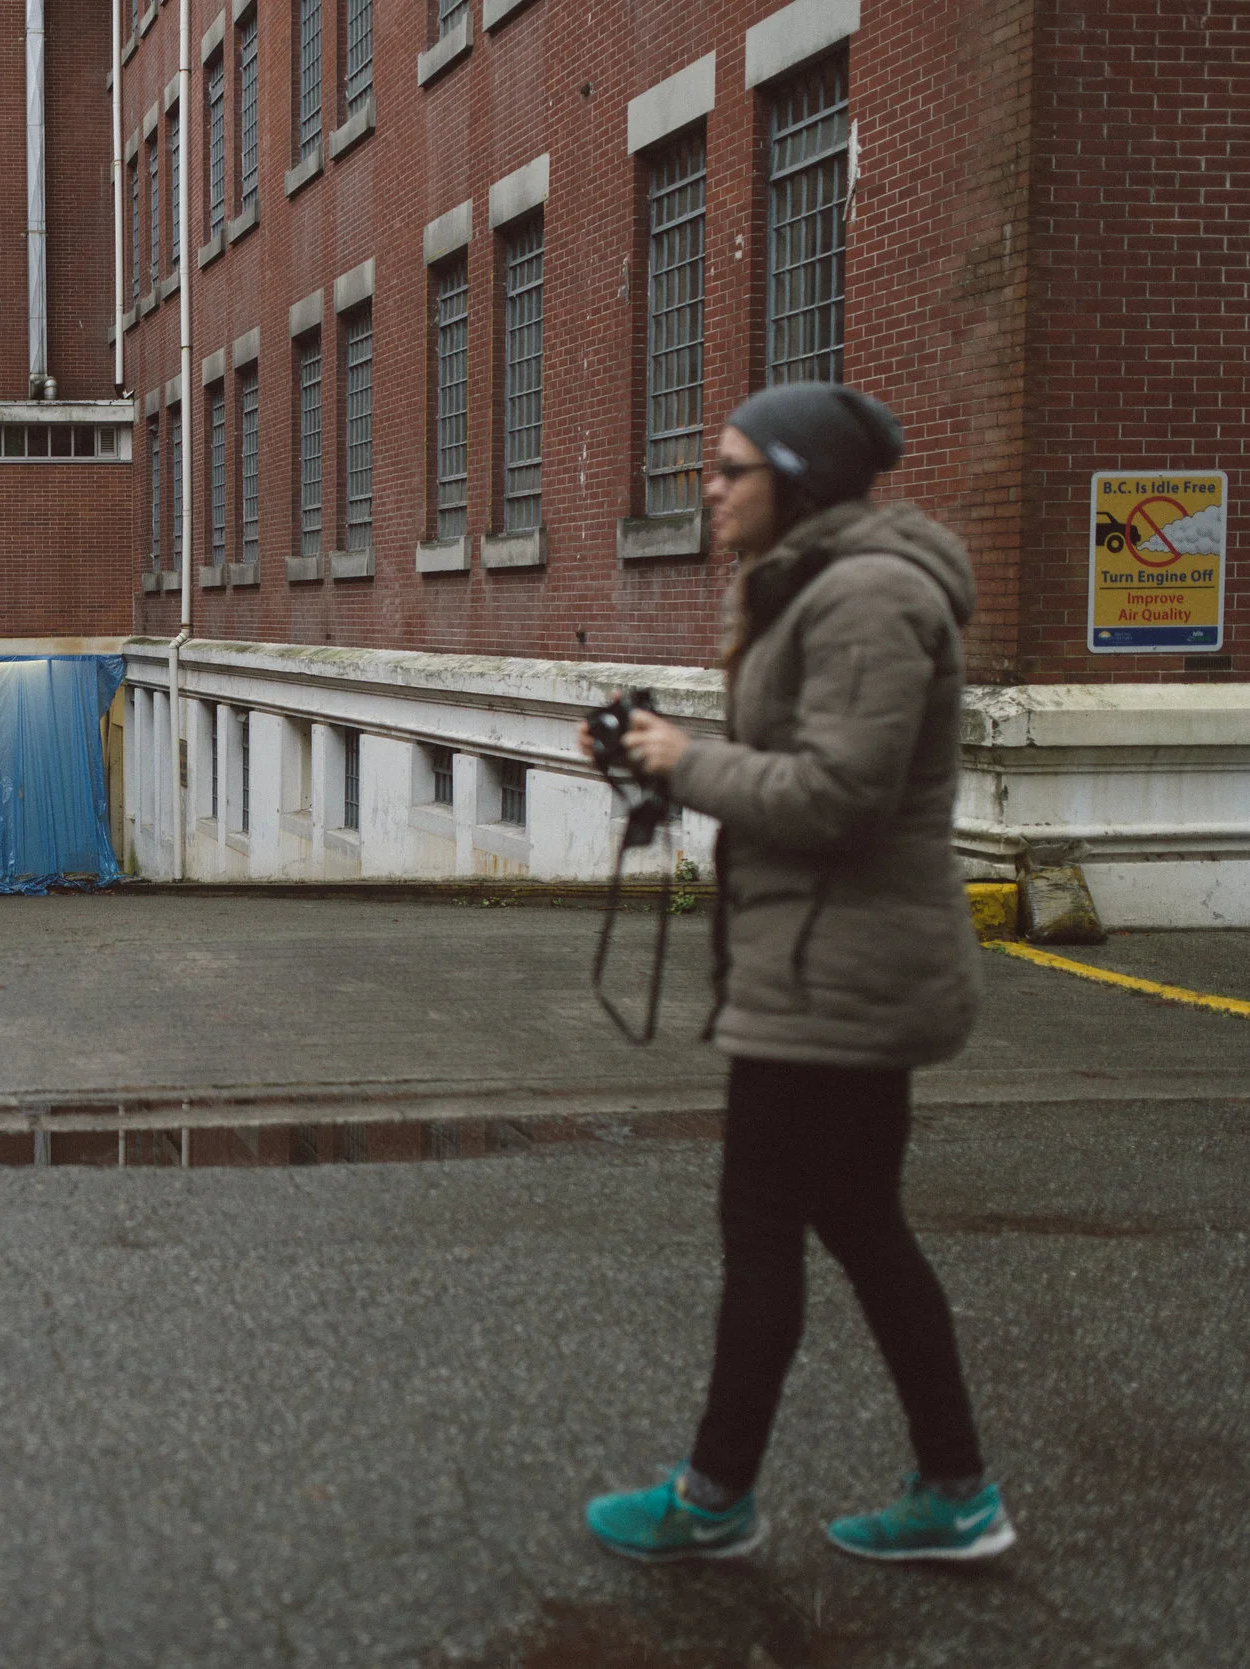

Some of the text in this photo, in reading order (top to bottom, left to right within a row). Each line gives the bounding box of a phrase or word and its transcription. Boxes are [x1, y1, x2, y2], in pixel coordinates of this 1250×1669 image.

[1103, 481, 1131, 494] B.C.
[1135, 481, 1147, 494] Is
[1183, 481, 1216, 493] Free
[1102, 569, 1214, 585] Turn Engine Off
[1127, 592, 1184, 606] Improve
[1118, 608, 1191, 623] Air Quality
